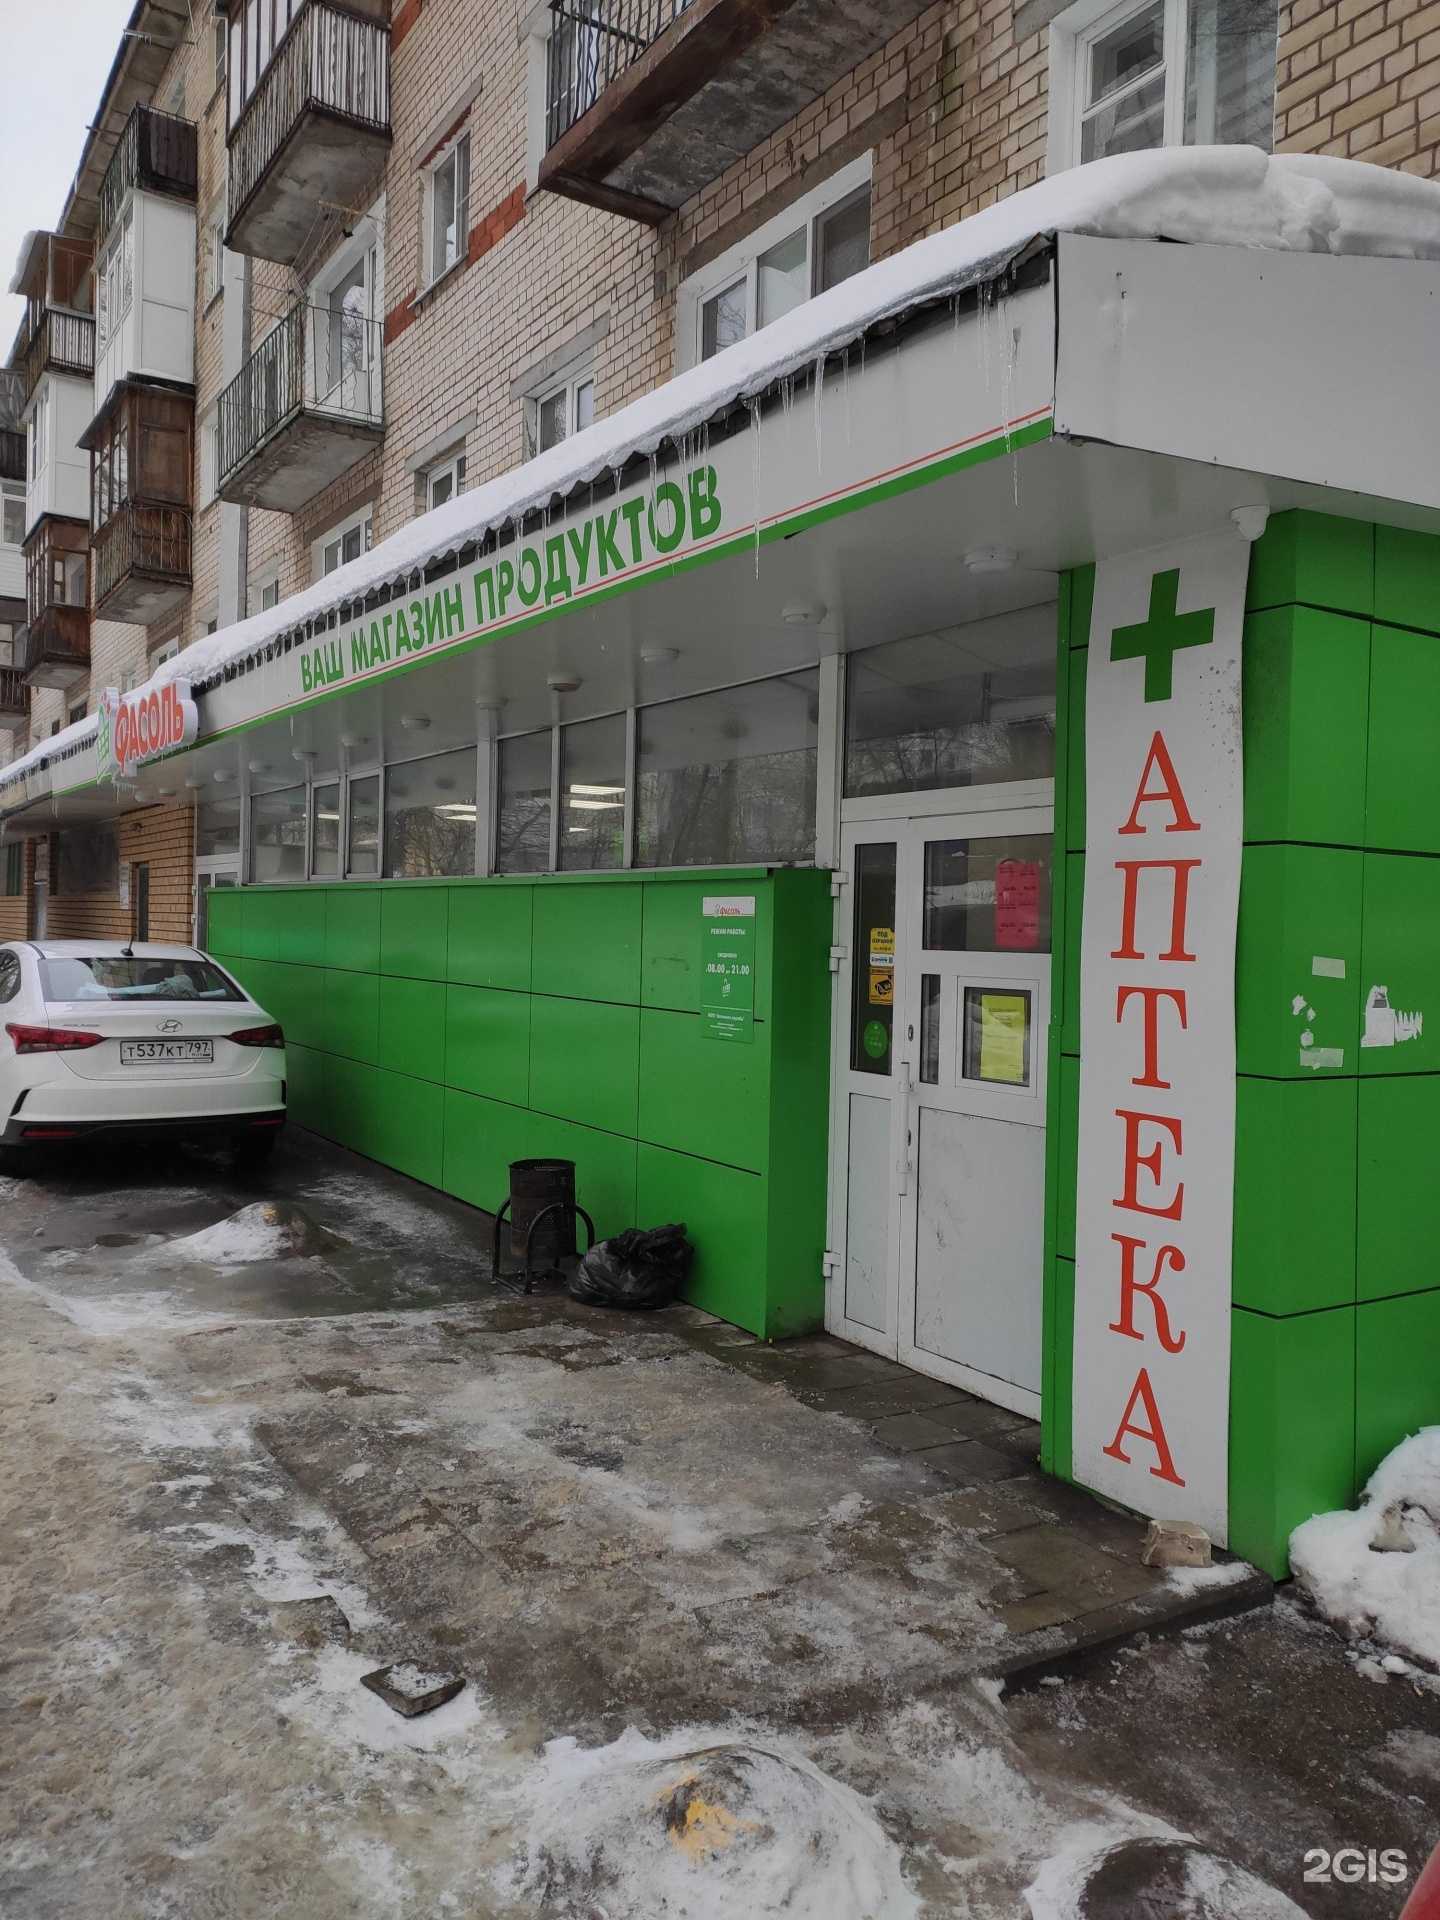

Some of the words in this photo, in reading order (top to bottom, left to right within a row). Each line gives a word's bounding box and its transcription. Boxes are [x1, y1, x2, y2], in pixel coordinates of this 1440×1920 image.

[300, 631, 344, 693] ВАШ
[351, 582, 465, 673] МАГАЗИН
[474, 464, 723, 625] ПРОДУКТОВ
[115, 682, 184, 775] ФАСОЛЬ
[1102, 730, 1202, 1487] АПТЕКА
